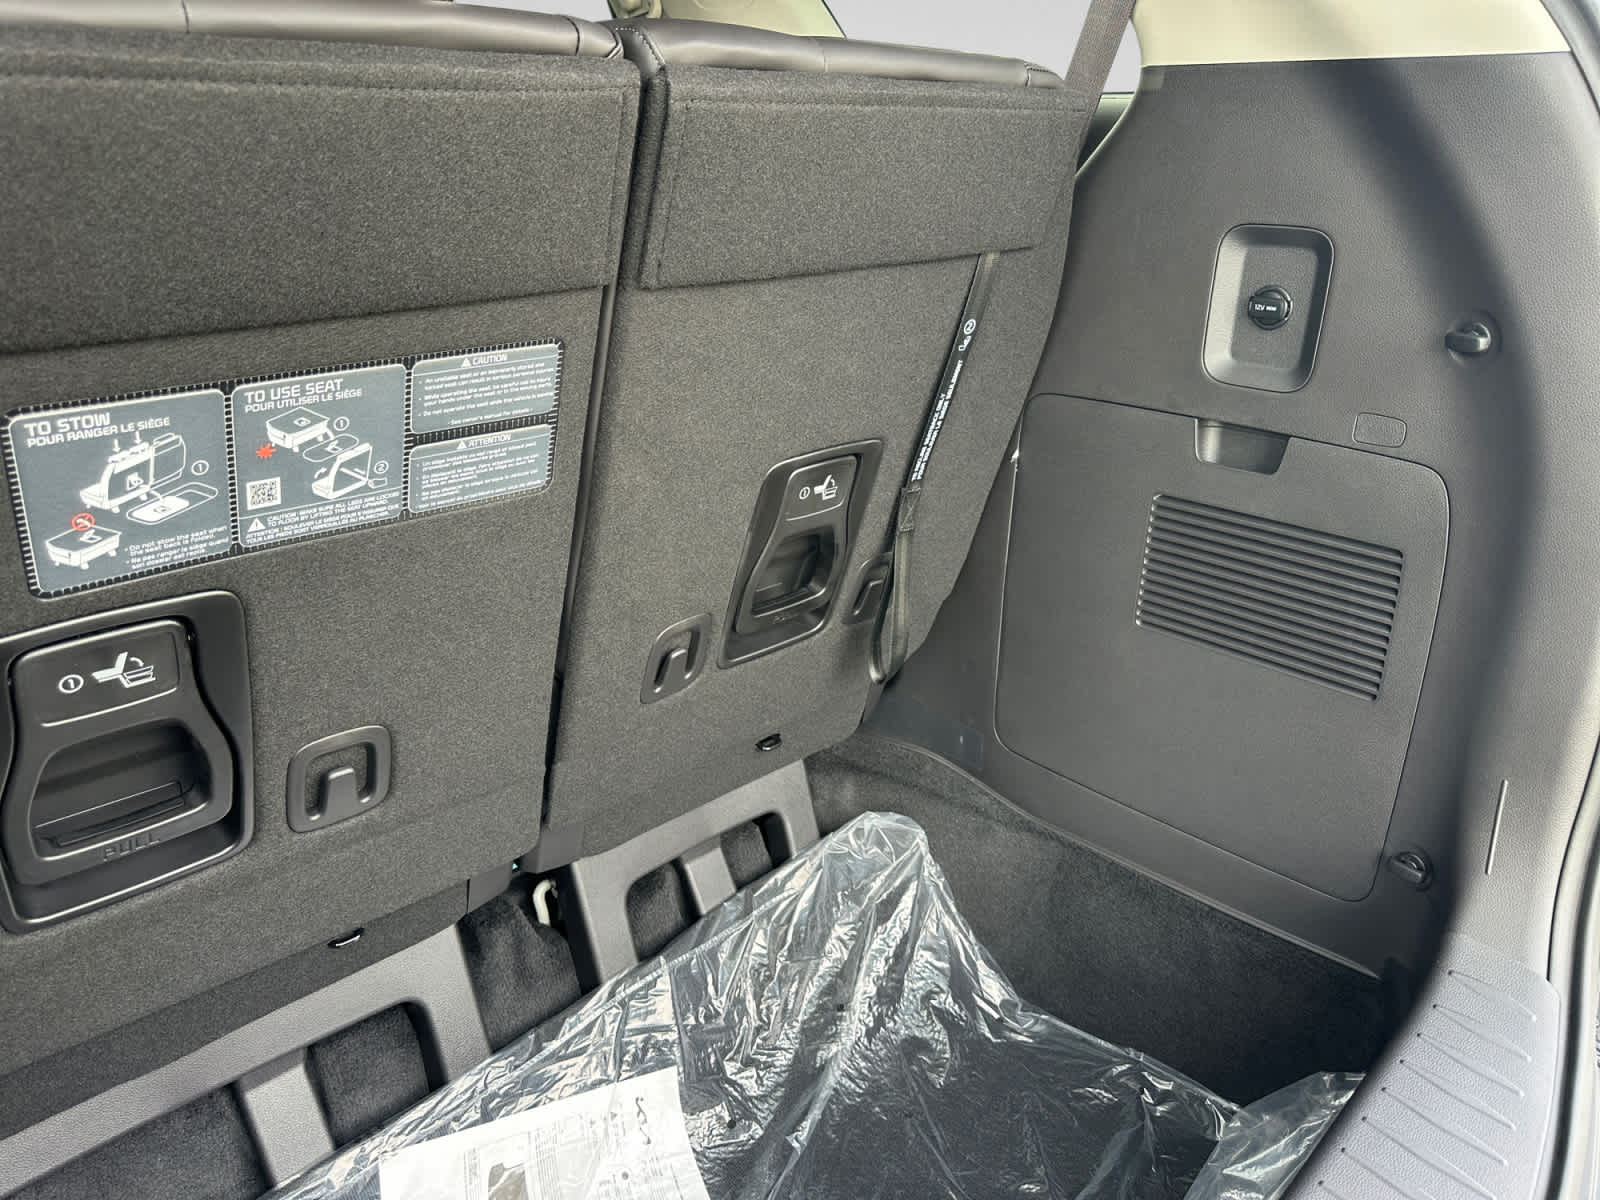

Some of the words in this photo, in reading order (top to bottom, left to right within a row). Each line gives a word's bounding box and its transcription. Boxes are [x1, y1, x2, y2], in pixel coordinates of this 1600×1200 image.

[472, 354, 508, 366] CAUTION
[244, 390, 265, 403] TO
[271, 384, 300, 400] USE
[306, 378, 343, 393] SEAT
[244, 402, 275, 413] POUR
[277, 395, 319, 409] UTILISER
[321, 393, 333, 403] LE
[24, 420, 51, 437] TO
[57, 412, 111, 434] STOW
[27, 433, 64, 448] POUR
[67, 425, 118, 442] RANGER
[120, 422, 135, 434] LE
[468, 433, 511, 447] ATTENTION
[103, 832, 161, 862] PULL
